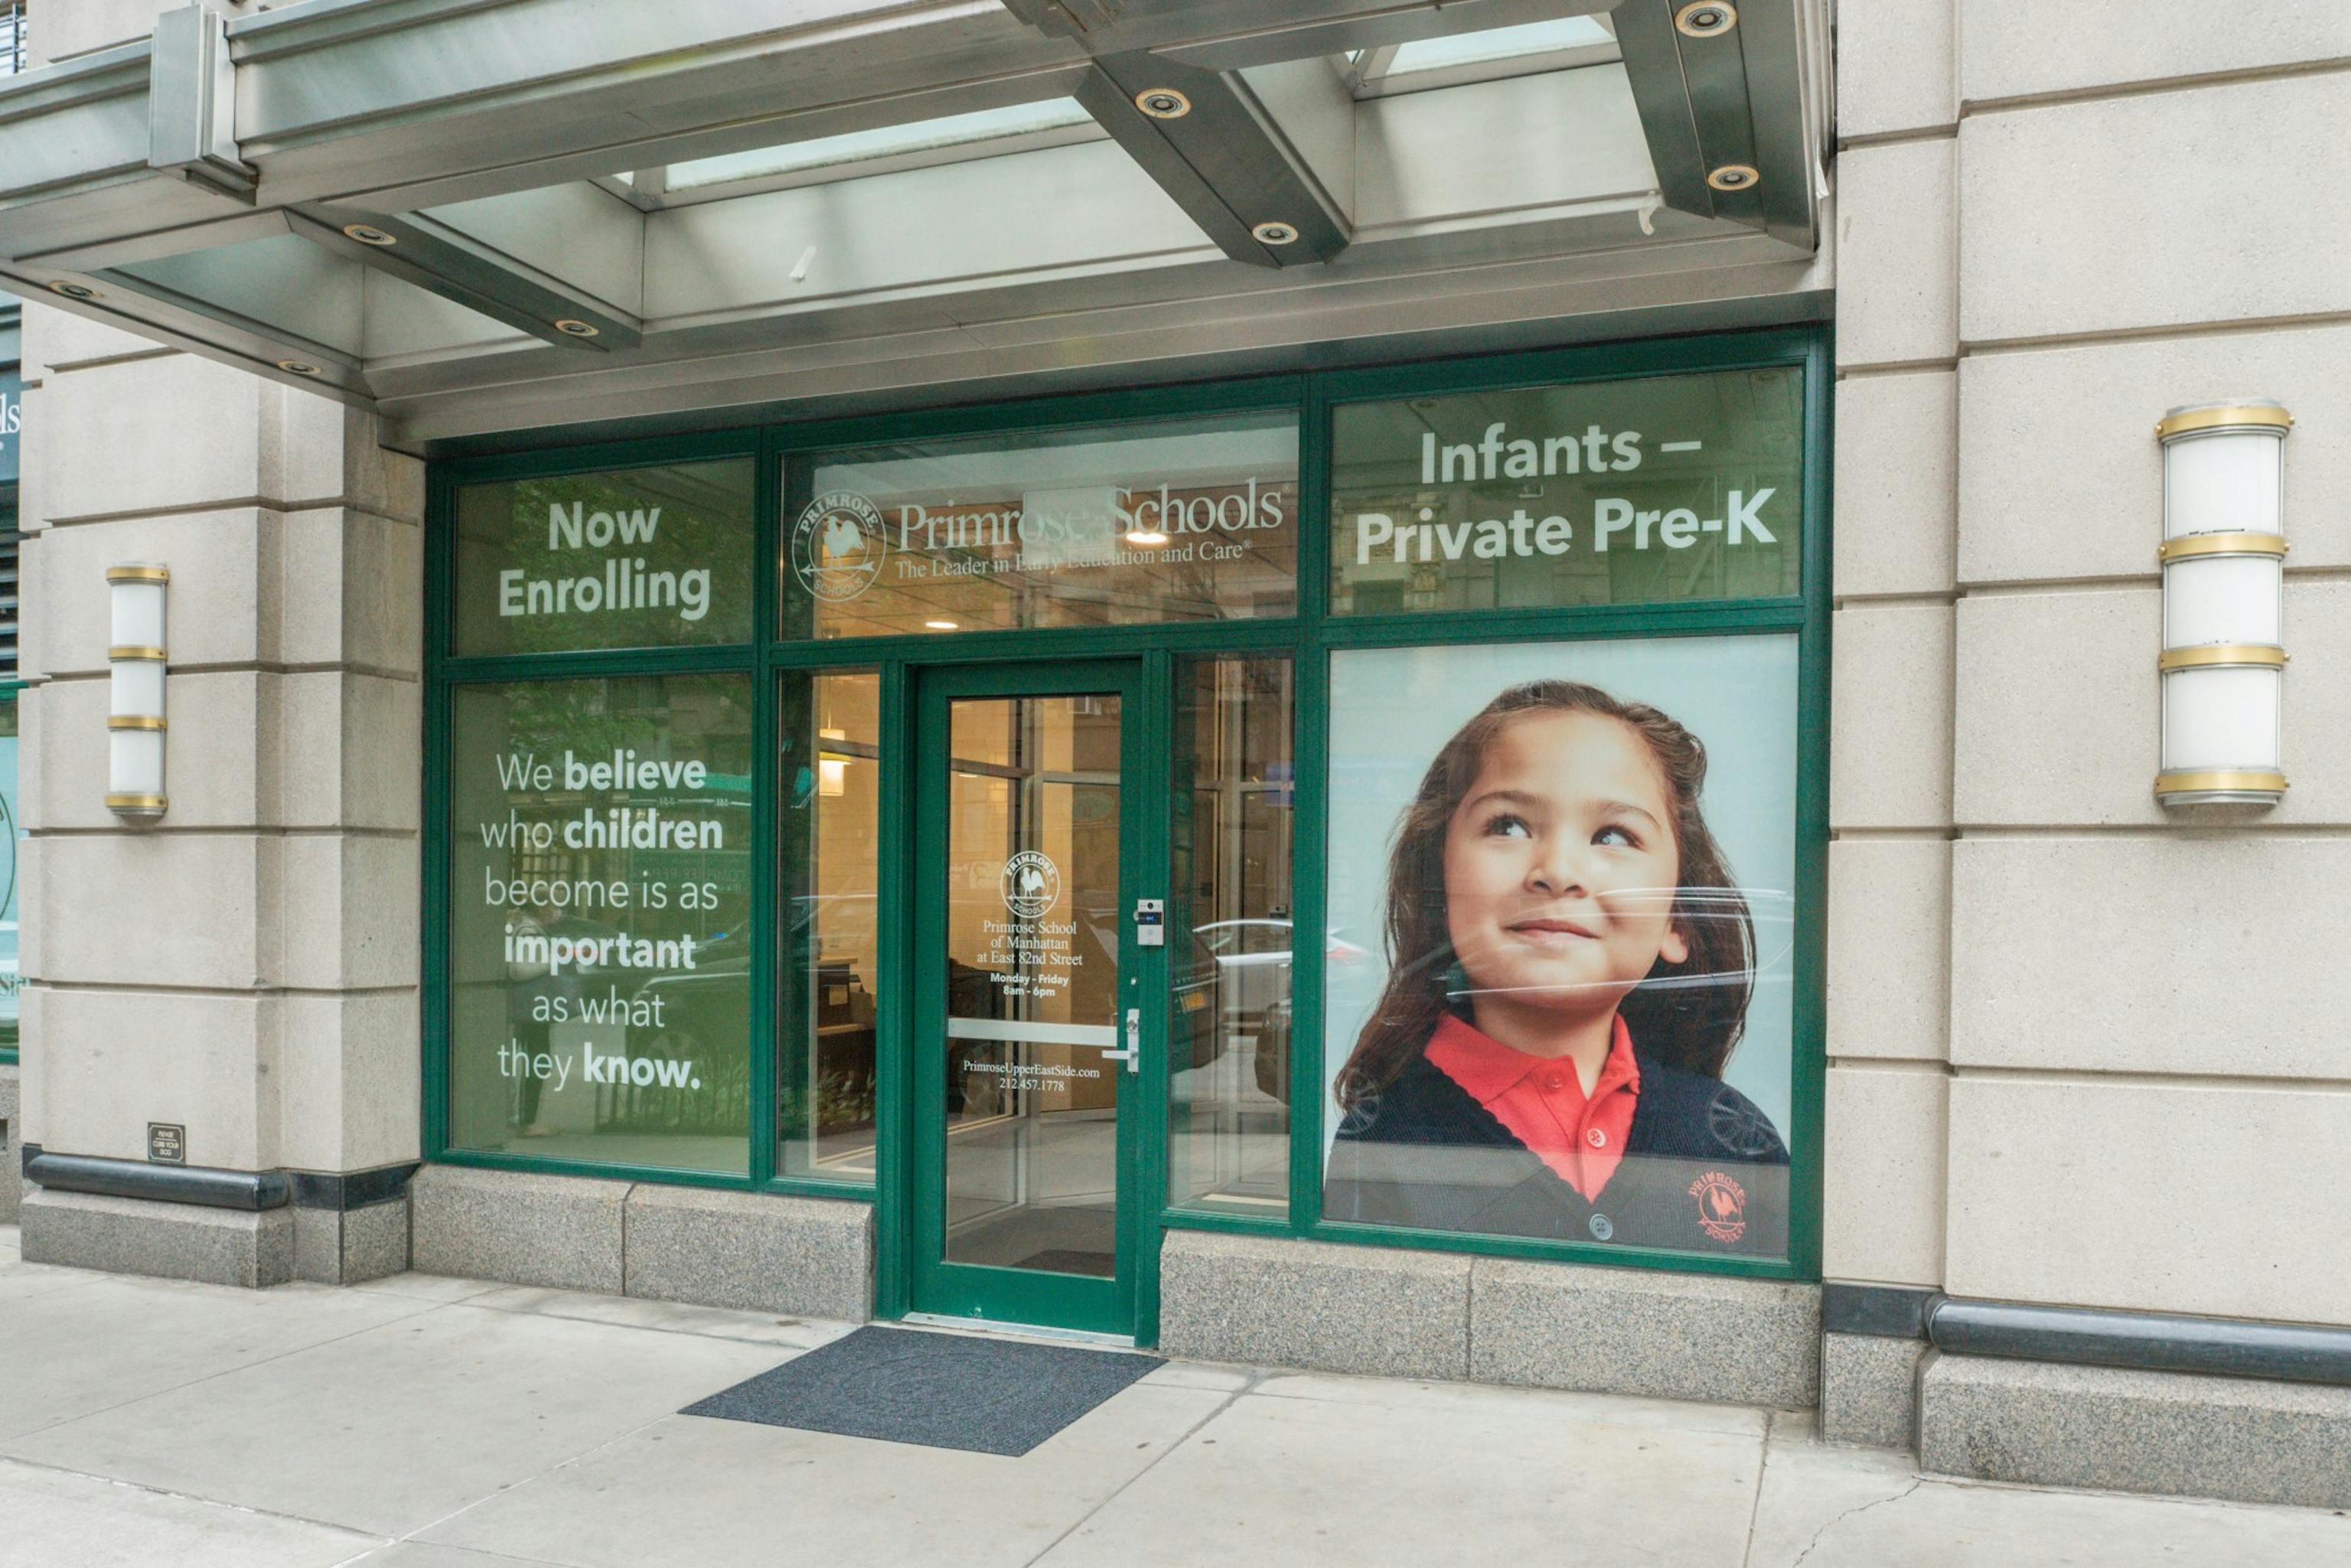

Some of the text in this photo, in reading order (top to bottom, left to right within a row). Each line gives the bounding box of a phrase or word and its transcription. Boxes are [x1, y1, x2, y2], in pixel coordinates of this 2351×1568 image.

[1422, 422, 1642, 484] Infants
[549, 501, 661, 550] Now
[800, 495, 880, 533] PRIMROSE
[895, 499, 1090, 552] Primrose
[1357, 488, 1778, 565] Private Pre-K
[895, 561, 925, 579] The
[932, 556, 990, 577] Leader
[994, 557, 1009, 573] in
[1068, 546, 1155, 569] Education
[1161, 542, 1193, 563] and
[500, 557, 710, 621] Enrolling
[814, 577, 864, 595] SCHOOLS
[496, 748, 707, 791] We believe
[481, 808, 723, 849] who children
[1006, 854, 1055, 877] PRIMROSE
[486, 866, 629, 908] become
[643, 870, 667, 908] is
[680, 882, 718, 910] as
[983, 920, 1077, 934] Primrose School
[1014, 903, 1046, 915] SCHOOLS
[504, 924, 696, 976] important
[977, 950, 1084, 966] at East 82nd Street
[990, 935, 1068, 950] of Manhattan
[990, 972, 1030, 986] Monday
[1039, 973, 1069, 987] Friday
[1003, 985, 1025, 995] 8am
[1032, 986, 1055, 998] 6pm
[533, 985, 665, 1028] as what
[497, 1038, 701, 1091] they know.
[964, 1060, 1100, 1078] PrimroseUpperEastSide.com
[999, 1077, 1065, 1091] 212.457.1778
